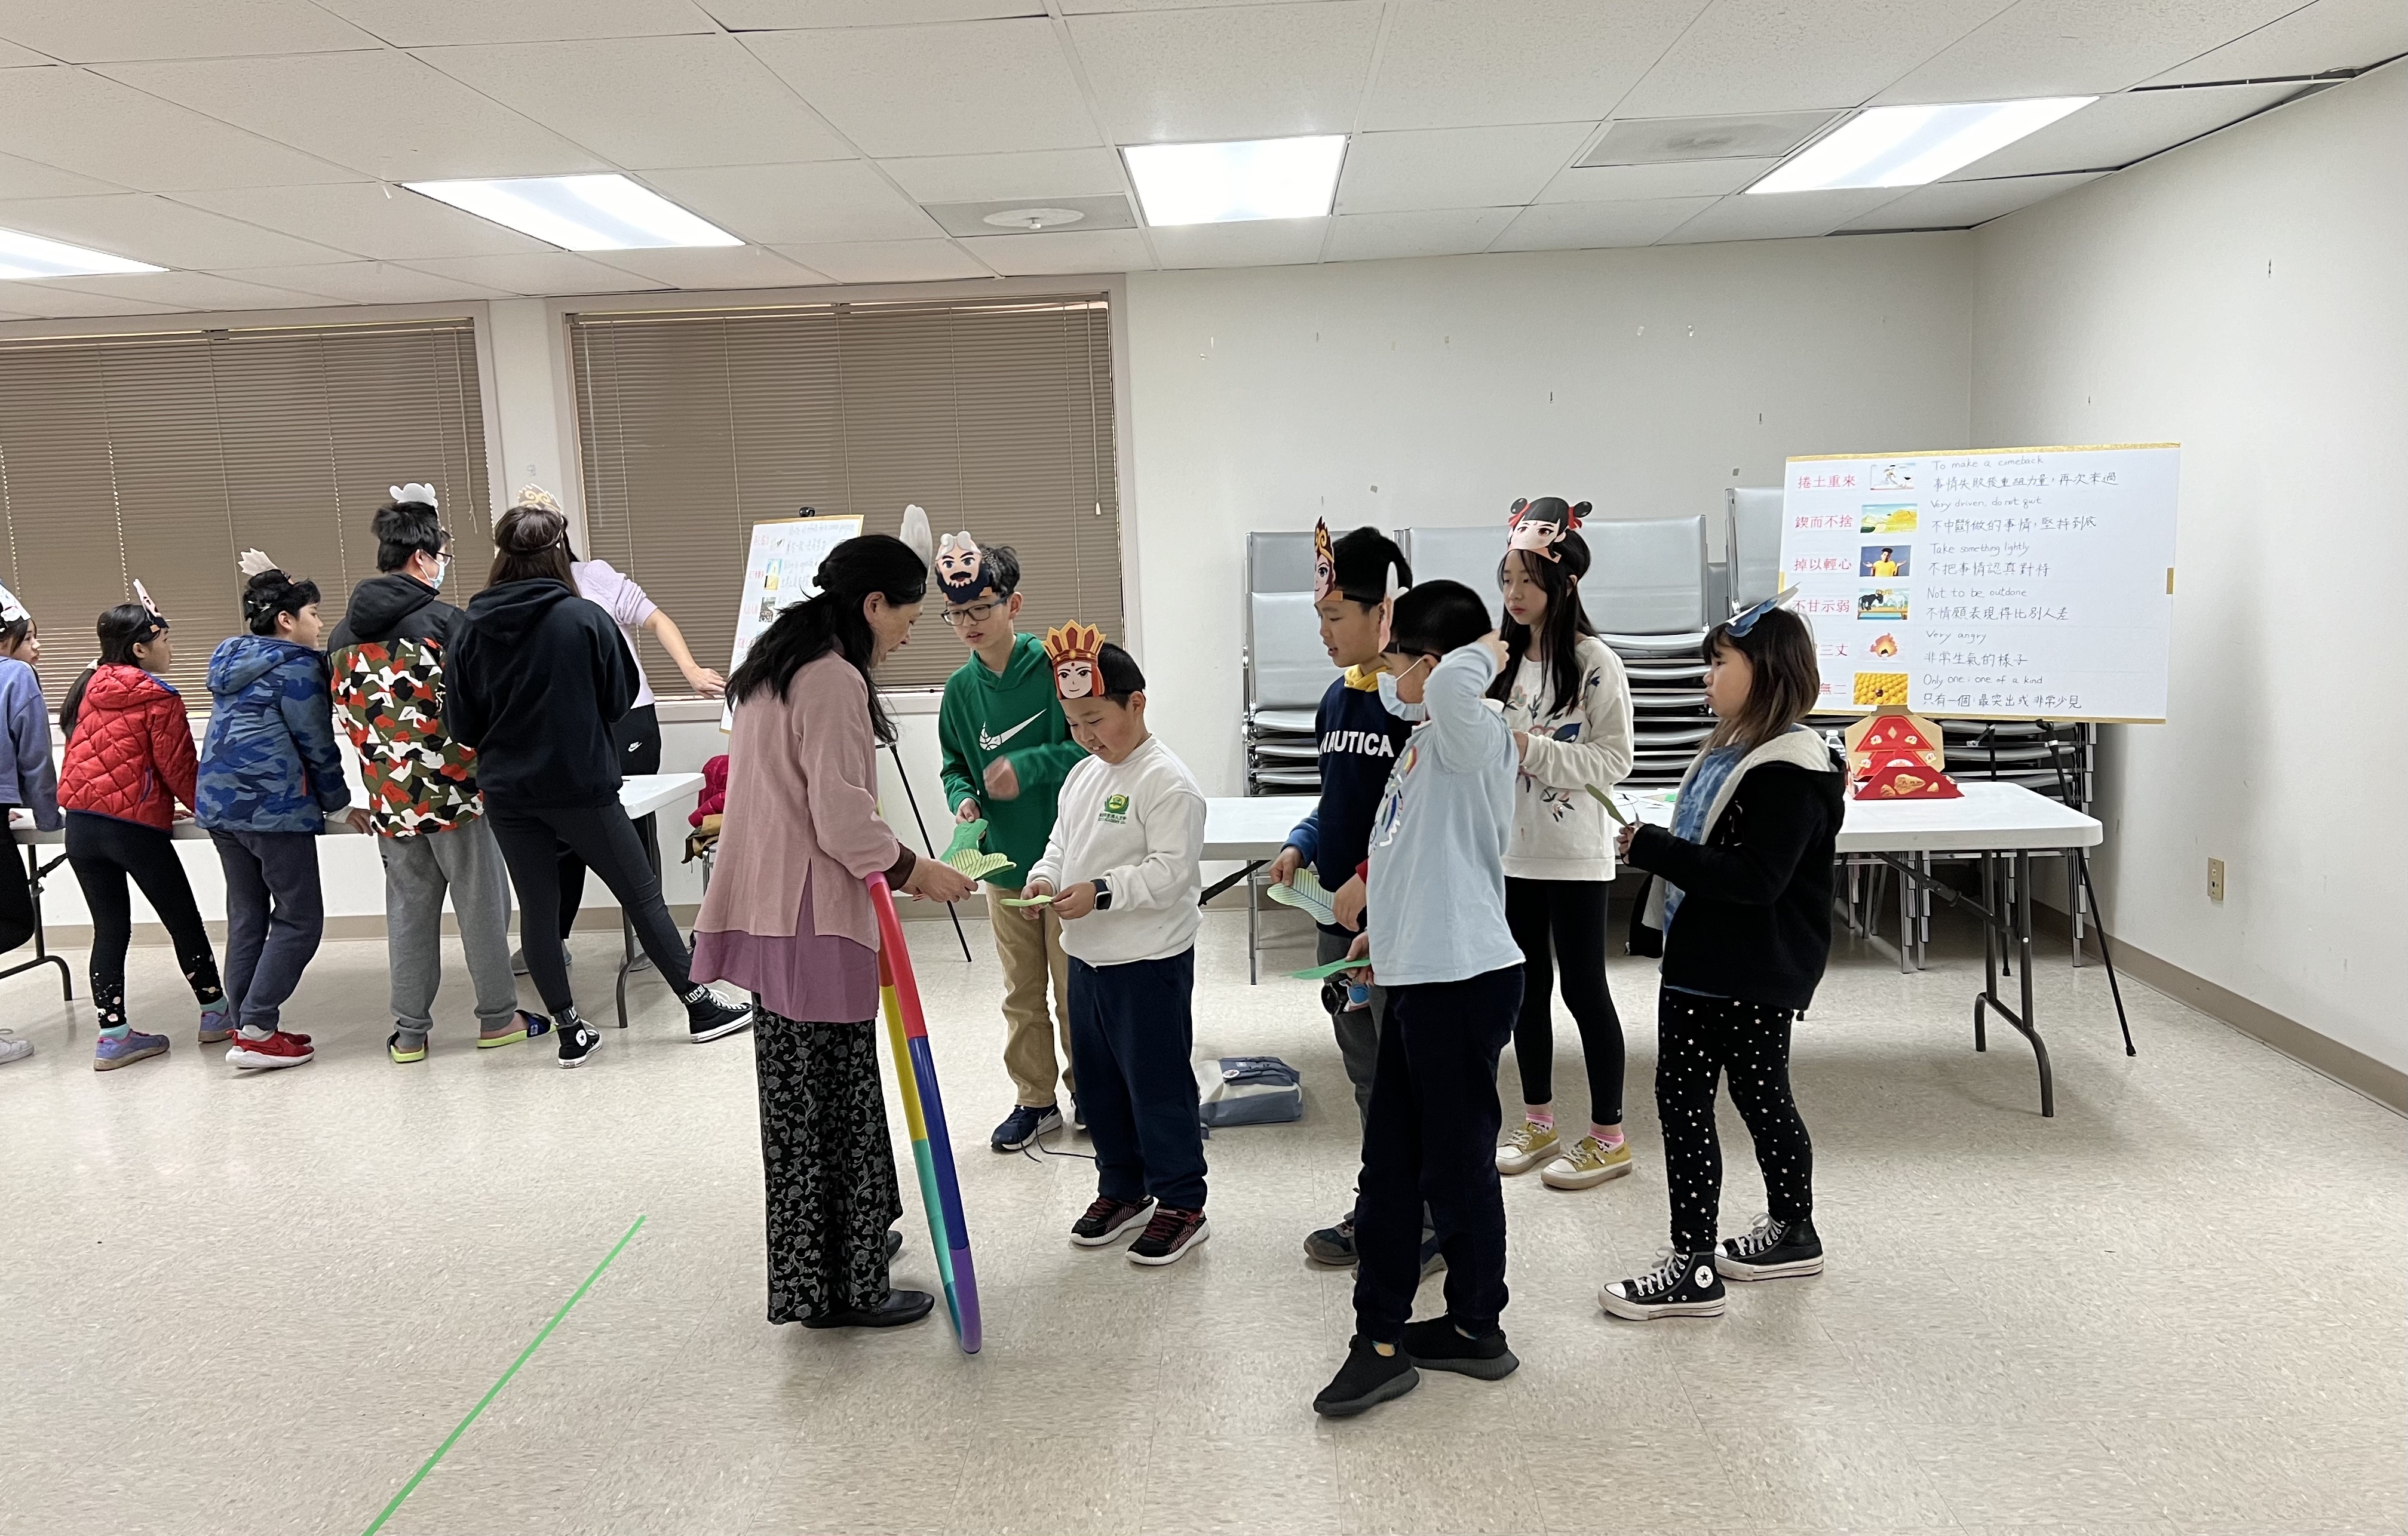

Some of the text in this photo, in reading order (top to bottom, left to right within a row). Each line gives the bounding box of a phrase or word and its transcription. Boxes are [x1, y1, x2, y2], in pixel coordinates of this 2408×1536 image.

[1931, 460, 1946, 471] To
[1952, 457, 1978, 469] make
[1998, 454, 2044, 467] comeback
[1797, 474, 1856, 489] 捲土重來
[1930, 499, 1952, 513] Very
[1991, 496, 2002, 506] do
[2022, 496, 2042, 509] quit
[1795, 514, 1854, 529] 鍥而不捨
[1930, 541, 2030, 557] Take something lightly
[1794, 557, 1852, 572] 掉以輕心
[1927, 561, 2051, 577] 不把事情認真對待
[1927, 586, 2028, 600] Not to be outdone
[1793, 599, 1850, 613] 不甘示弱
[1925, 629, 1987, 645] Very angry
[1815, 643, 1849, 657] 三丈
[1923, 651, 2029, 668] 非常生氣的樣子
[1923, 674, 1944, 690] Only
[1996, 675, 2007, 684] of
[2023, 675, 2043, 684] kind
[1319, 730, 1394, 757] NAUTICA
